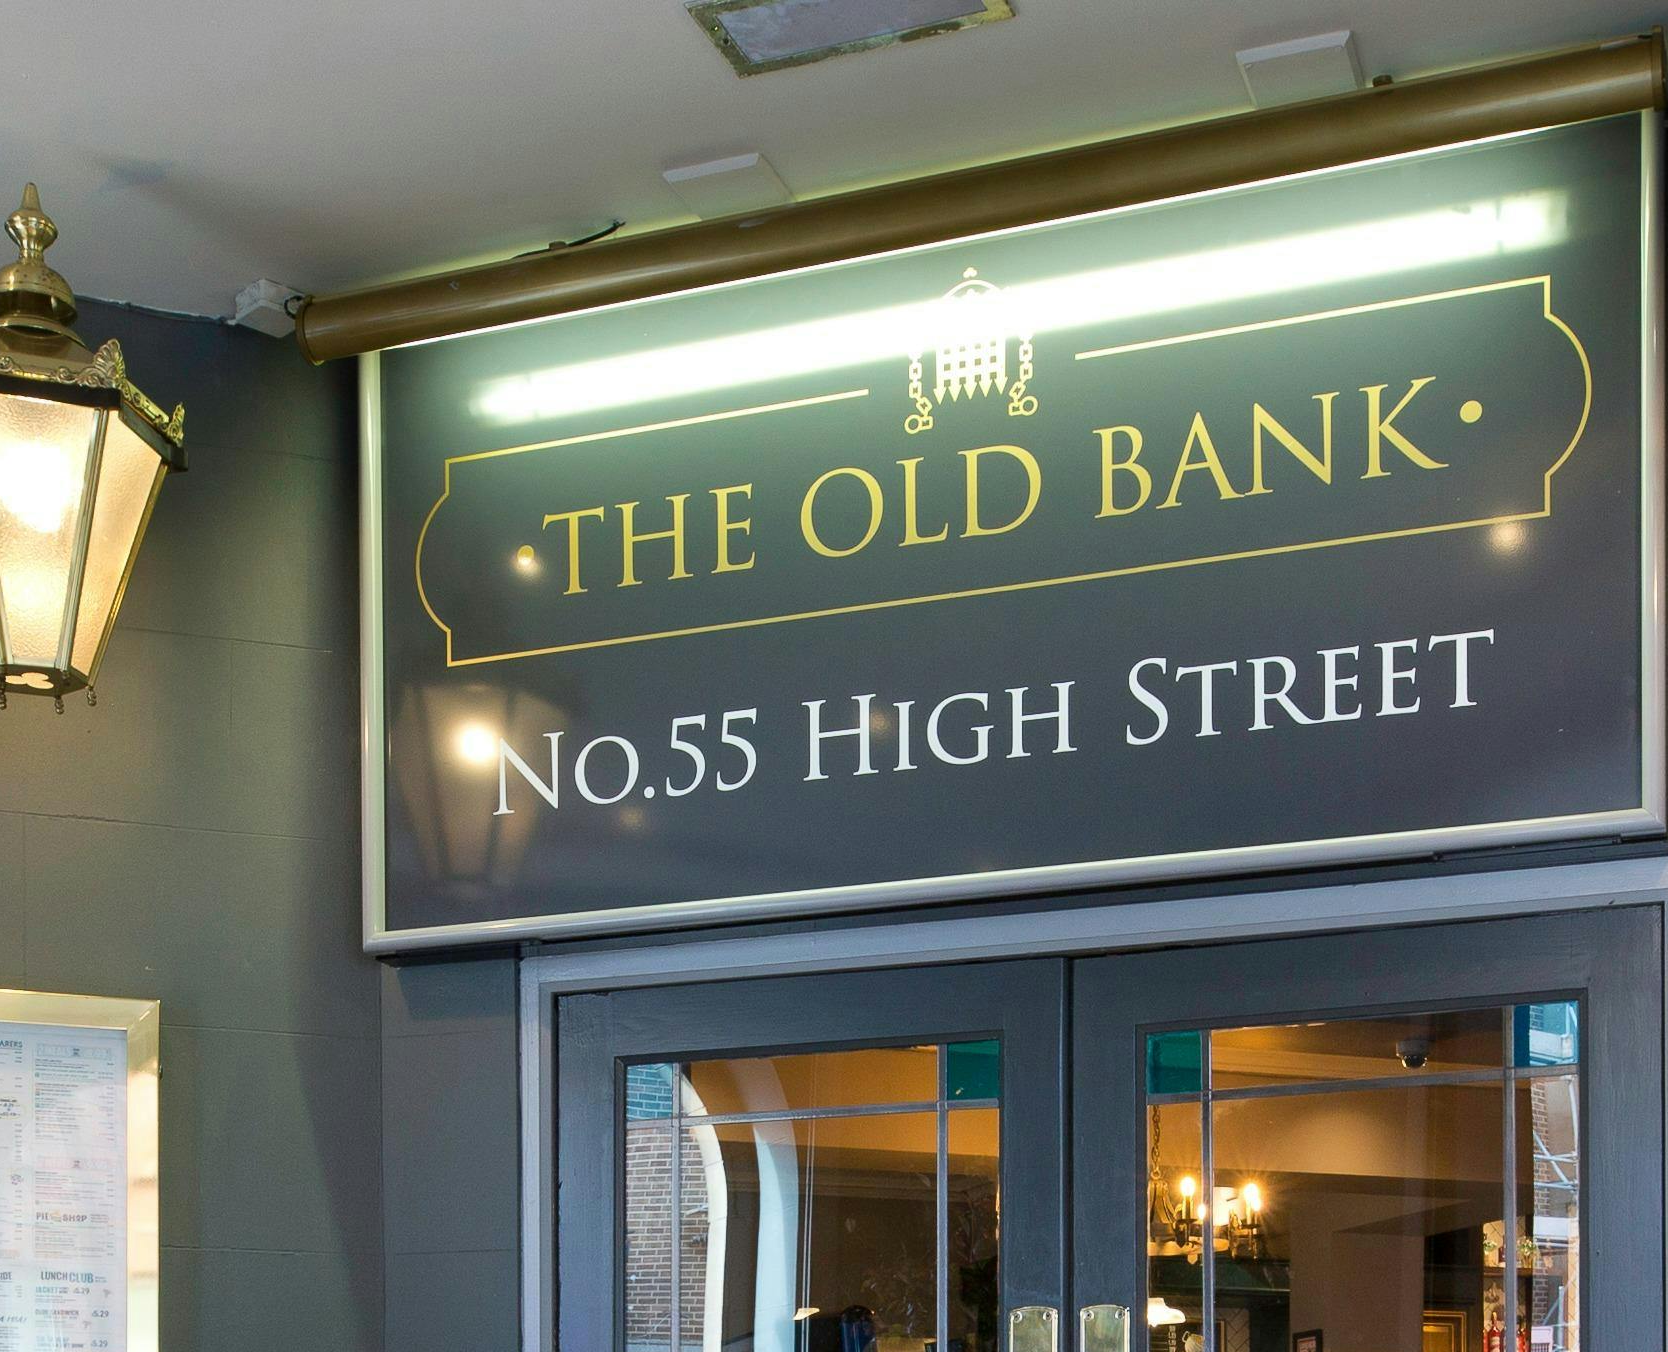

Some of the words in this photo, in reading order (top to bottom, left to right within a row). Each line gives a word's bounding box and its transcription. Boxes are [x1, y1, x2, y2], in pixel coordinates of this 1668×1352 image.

[542, 483, 756, 595] THE
[801, 445, 1042, 557] OLD
[1094, 377, 1448, 519] BANK
[41, 1271, 68, 1281] LUNCH
[69, 1272, 94, 1284] CLUB
